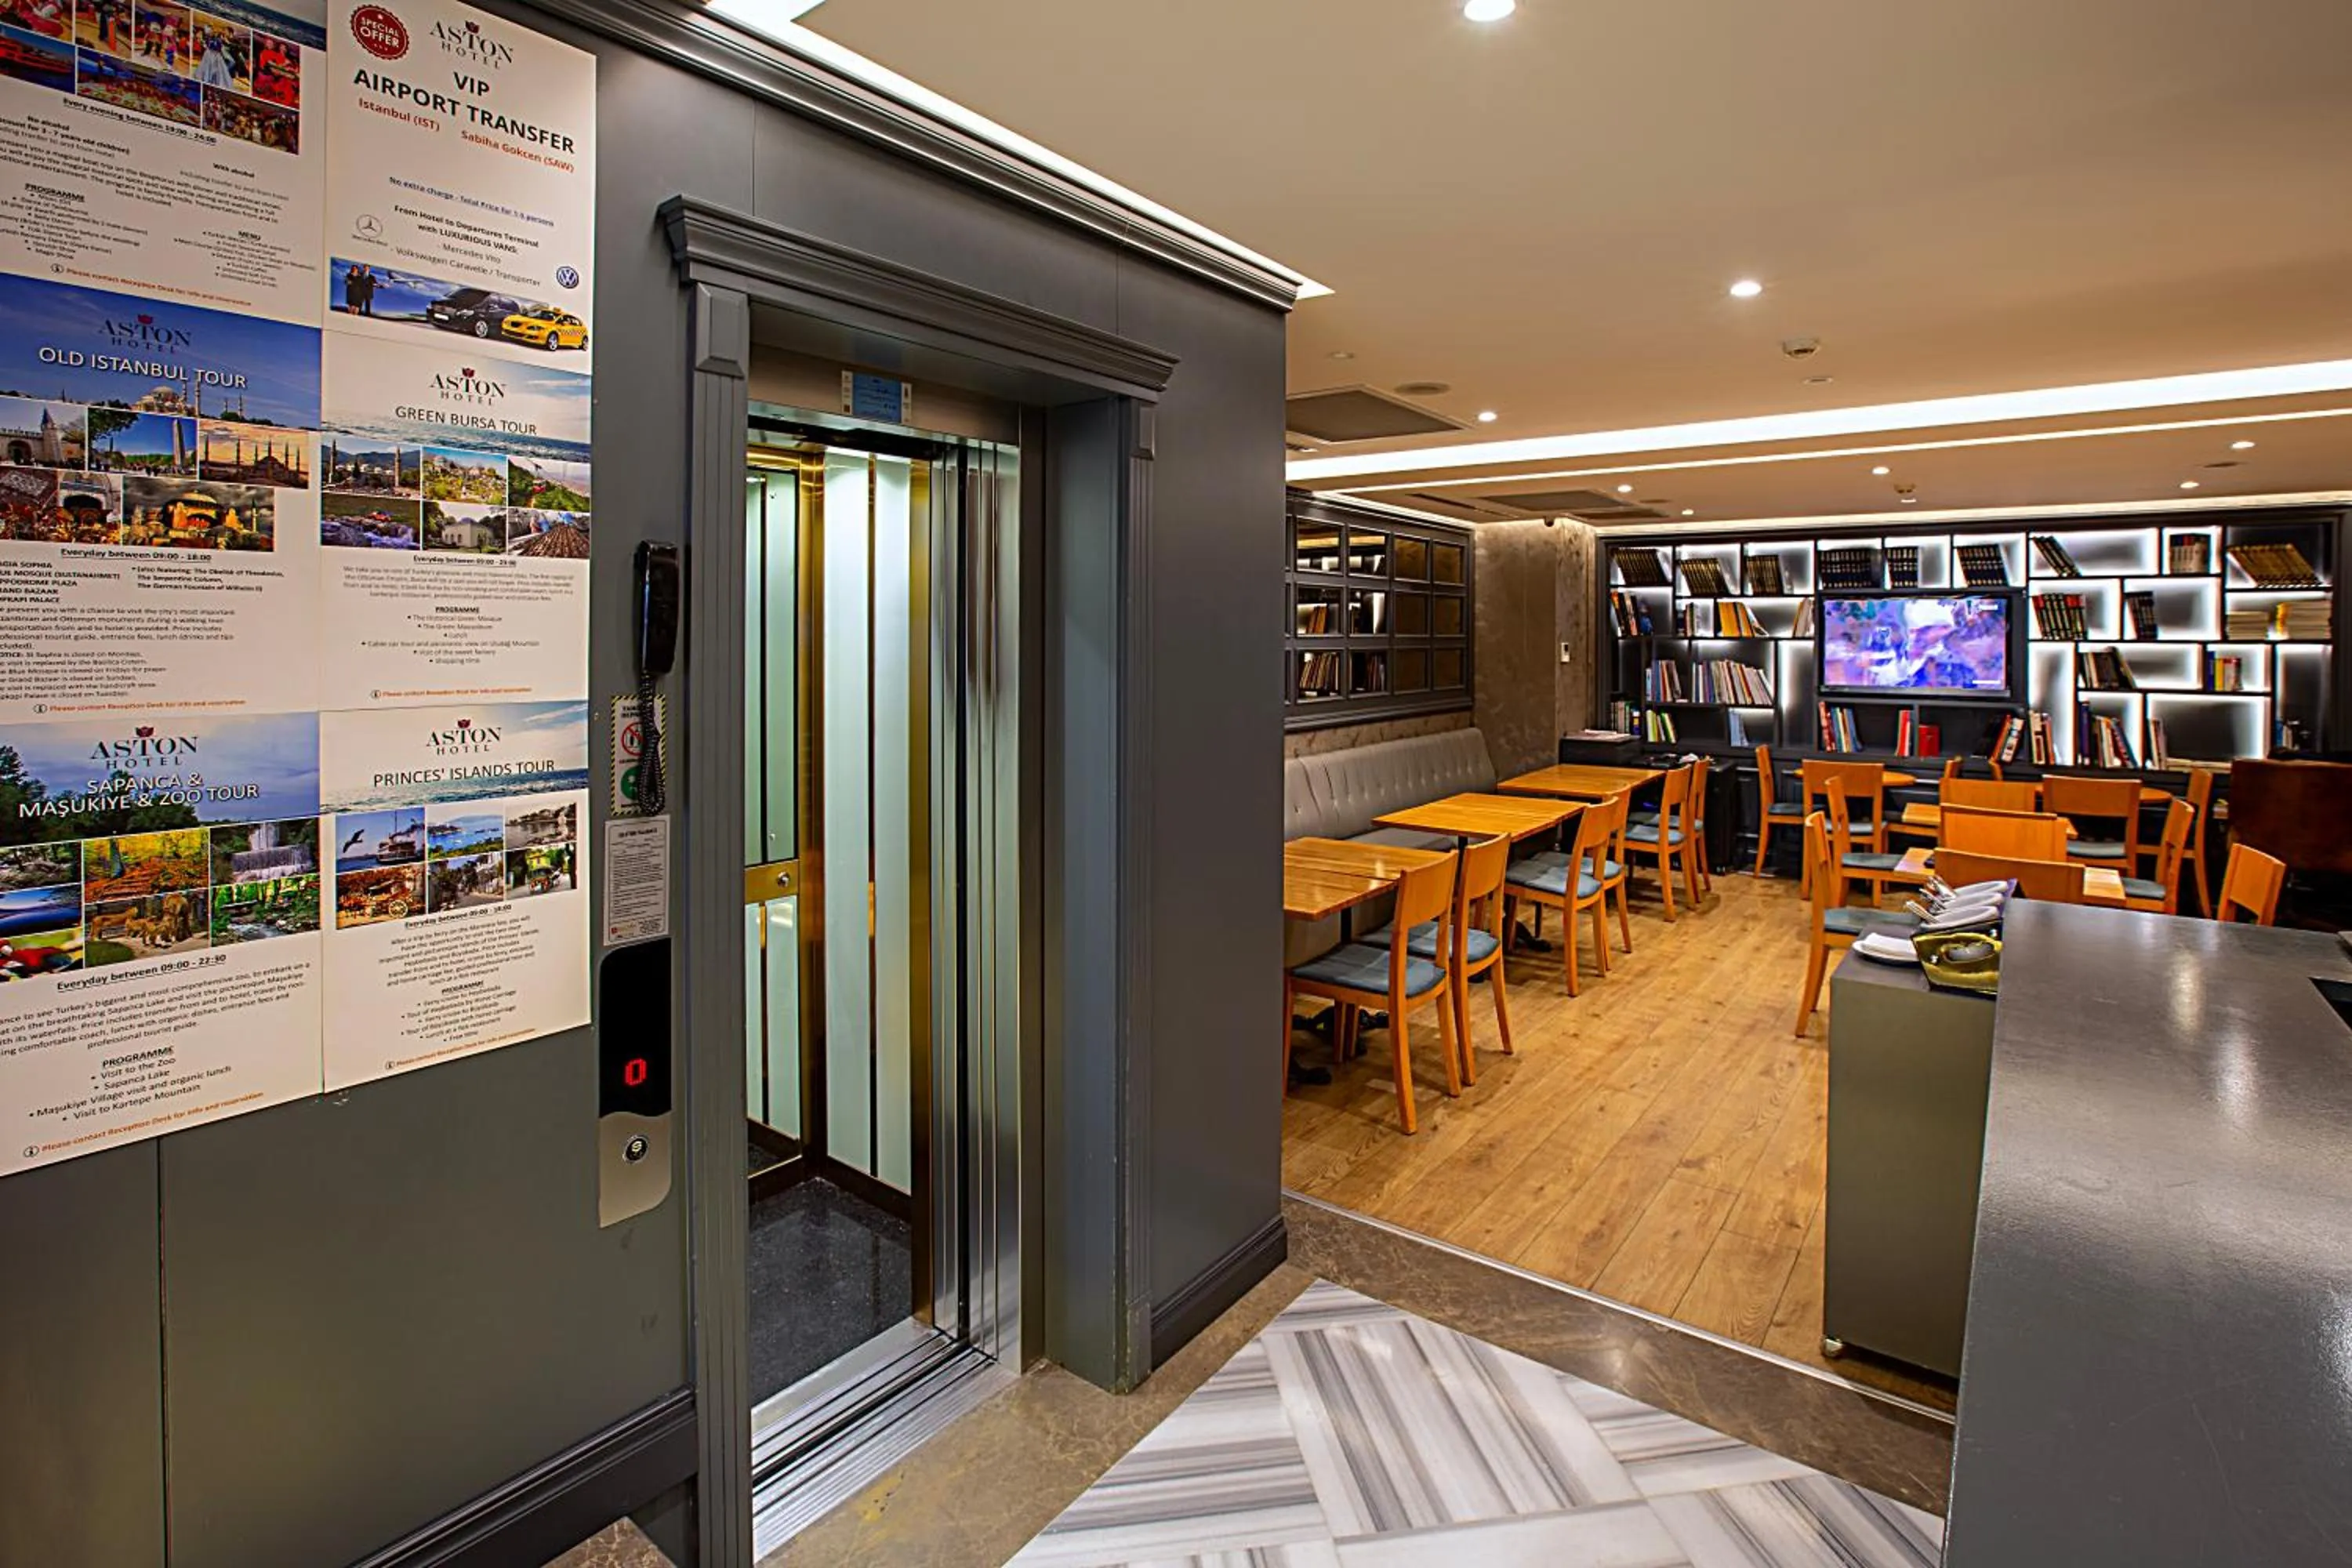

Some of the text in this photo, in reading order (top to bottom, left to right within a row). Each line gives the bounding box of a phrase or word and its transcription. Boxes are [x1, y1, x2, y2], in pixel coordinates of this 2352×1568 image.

[360, 26, 399, 48] OFFER
[430, 20, 514, 64] ASTON
[441, 42, 500, 70] HOTEL
[453, 72, 490, 96] VIP
[354, 69, 575, 154] AIRPORT TRANSFER
[358, 97, 441, 132] Istanbul (IST)
[461, 129, 499, 150] Sabiha
[394, 205, 418, 217] From
[420, 211, 444, 223] Hotel
[456, 221, 503, 240] Departures
[440, 229, 492, 247] LUXURIOUS
[396, 247, 448, 267] Volkswagen
[98, 318, 191, 347] ASTON
[111, 337, 177, 354] HOTEL
[39, 347, 248, 389] OLD ISTANBUL TOUR
[430, 374, 506, 397] ASTON
[441, 390, 495, 405] HOTEL
[395, 406, 537, 435] GREEN BURSA TOUR
[60, 548, 105, 558] Everyday
[109, 550, 151, 559] between
[90, 736, 199, 760] ASTON
[426, 728, 502, 746] ASTON
[437, 745, 490, 755] HOTEL
[106, 757, 183, 769] HOTEL
[374, 760, 555, 787] PRINCES' ISLANDS TOUR
[87, 771, 203, 795] SAPANCA &
[137, 793, 154, 807] &
[159, 790, 201, 806] ZOO
[207, 784, 259, 800] TOUR
[57, 975, 107, 990] Everyday
[111, 966, 158, 981] between
[47, 1011, 105, 1026] breathtaking
[56, 1003, 93, 1015] Turkey's
[100, 1067, 122, 1079] Visit
[139, 1062, 154, 1071] the
[157, 1058, 176, 1068] Zoo
[102, 1047, 174, 1069] PROGRAMME
[103, 1070, 170, 1091] Sapanca Lake
[625, 1058, 647, 1087] 0
[74, 1107, 96, 1120] Visit
[99, 1105, 110, 1114] to
[154, 1083, 201, 1101] Mountain
[90, 1091, 124, 1105] Village
[126, 1084, 147, 1096] visit
[149, 1080, 168, 1091] and
